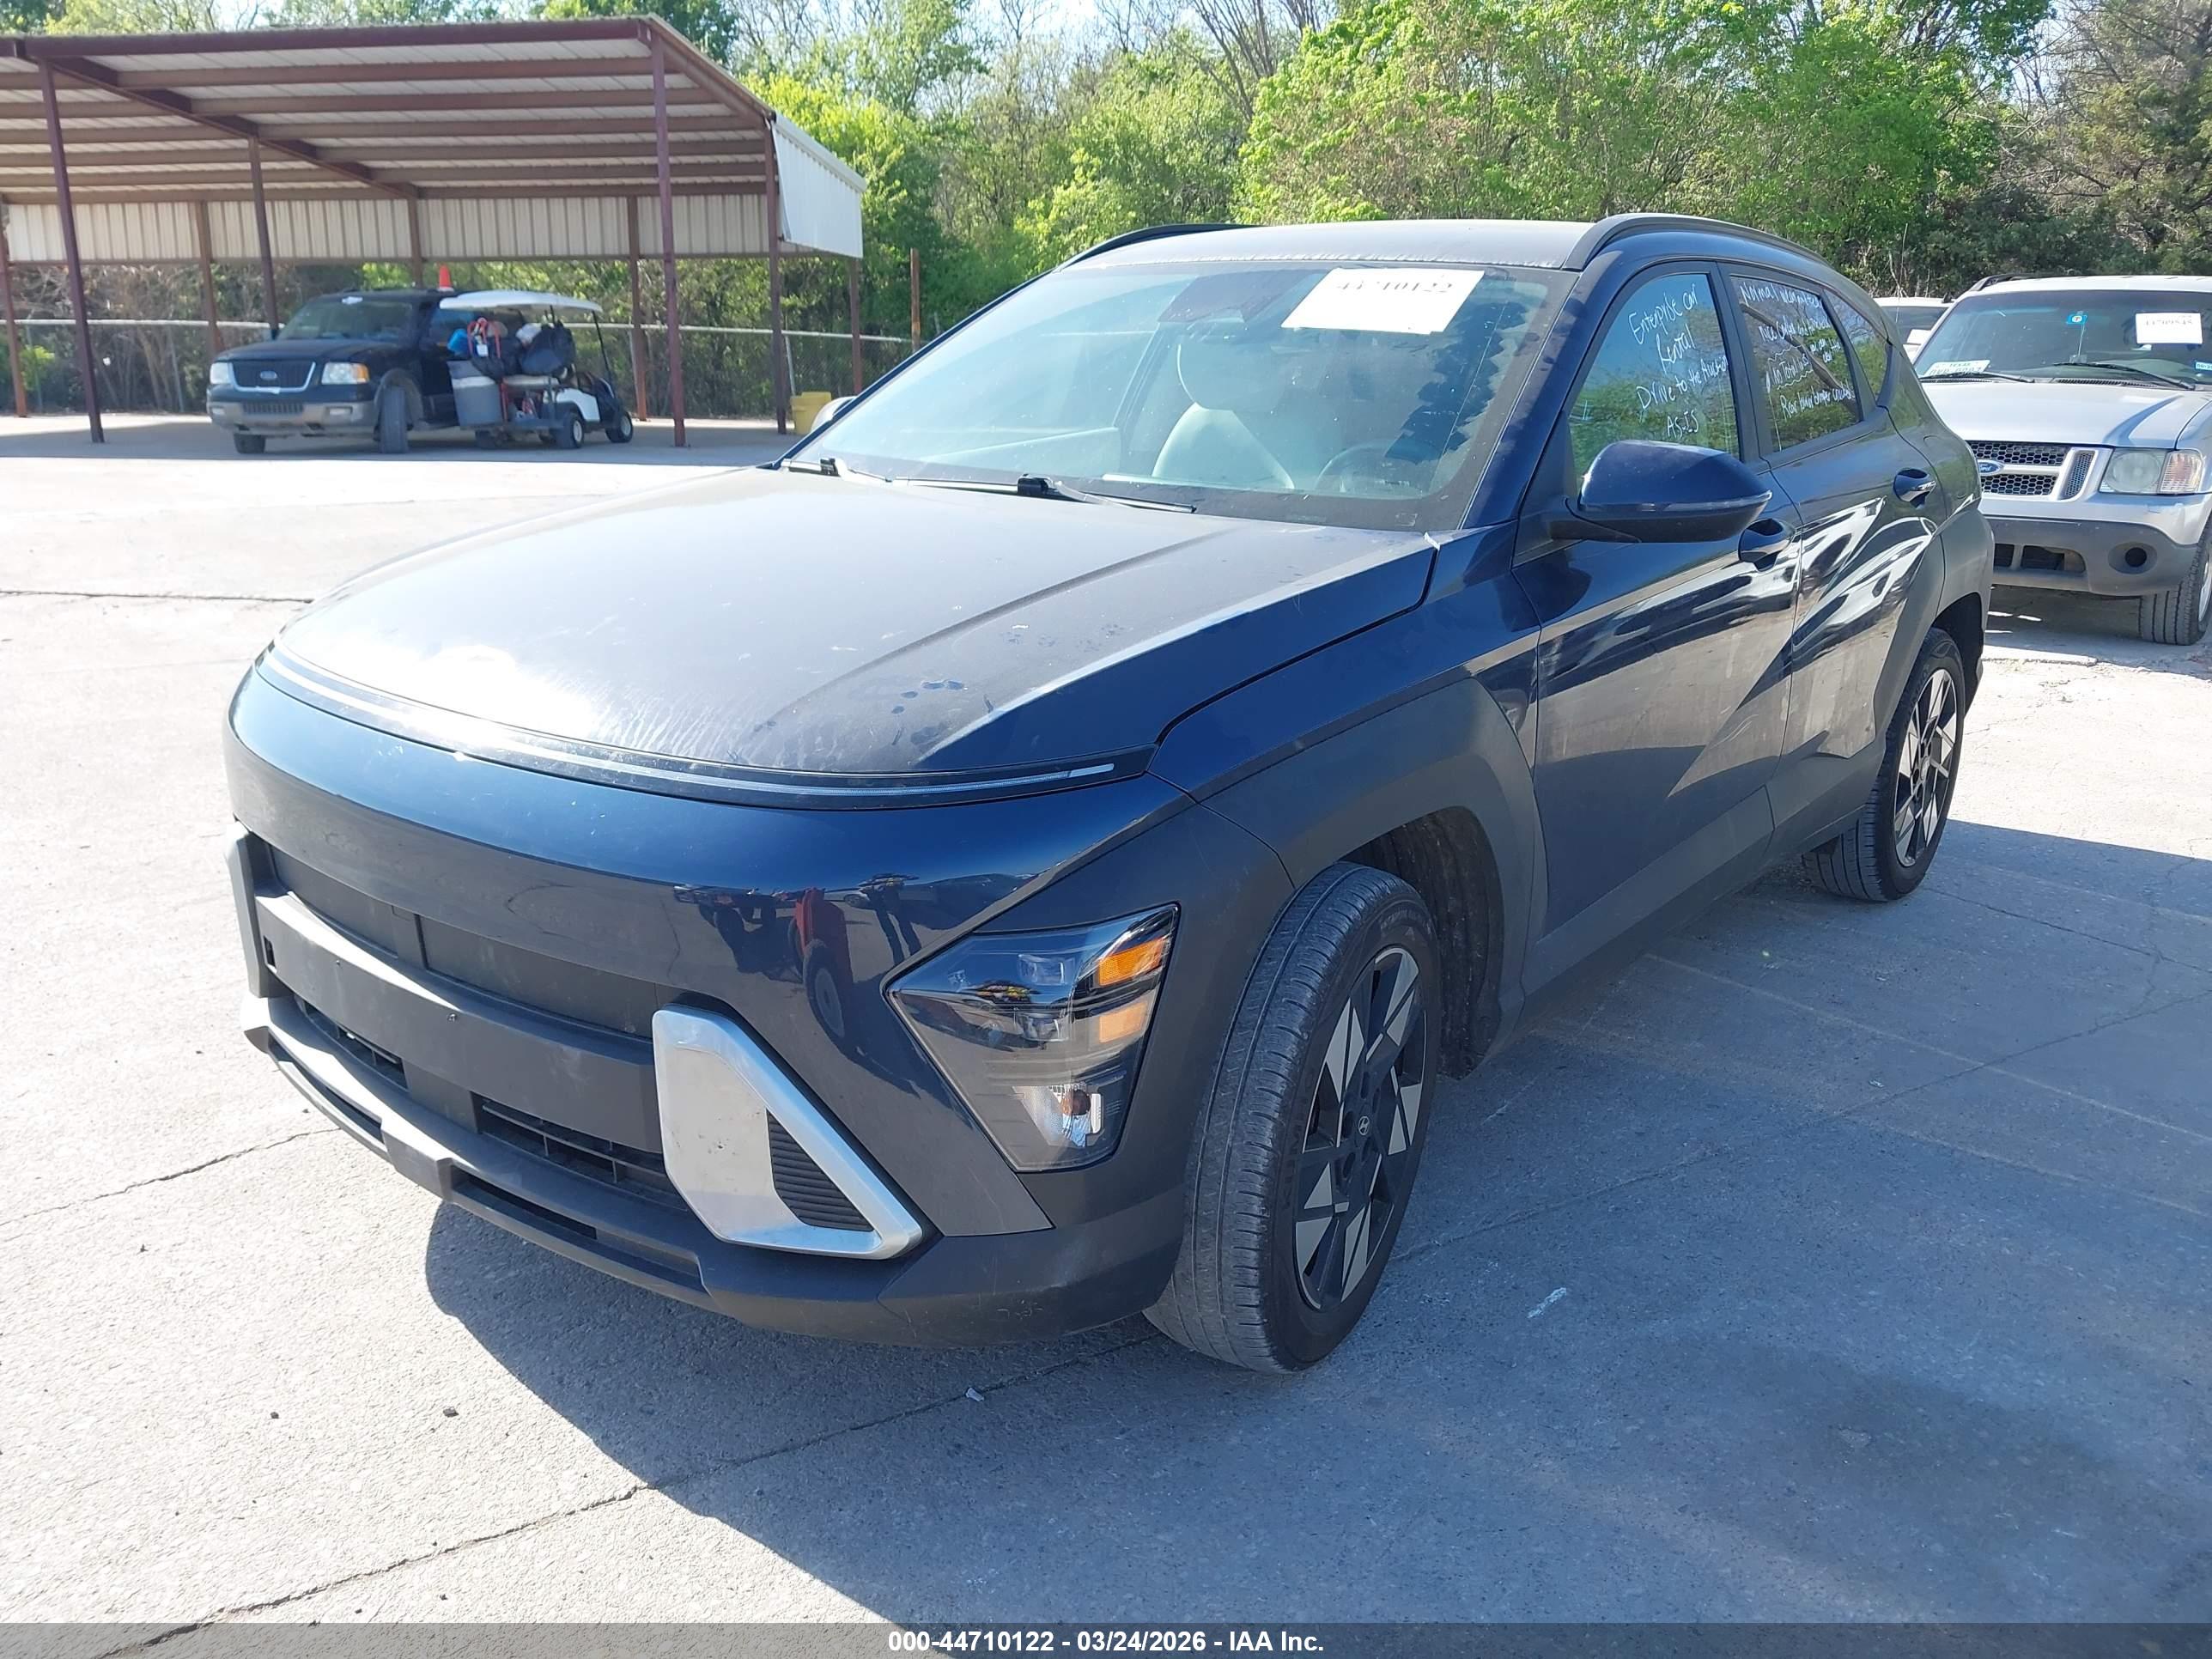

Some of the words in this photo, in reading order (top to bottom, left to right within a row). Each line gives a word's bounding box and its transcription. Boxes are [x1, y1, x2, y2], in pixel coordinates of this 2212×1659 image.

[1740, 282, 1779, 307] Normal
[1636, 381, 1675, 409] Drive
[1674, 375, 1687, 394] to
[1688, 369, 1702, 386] the
